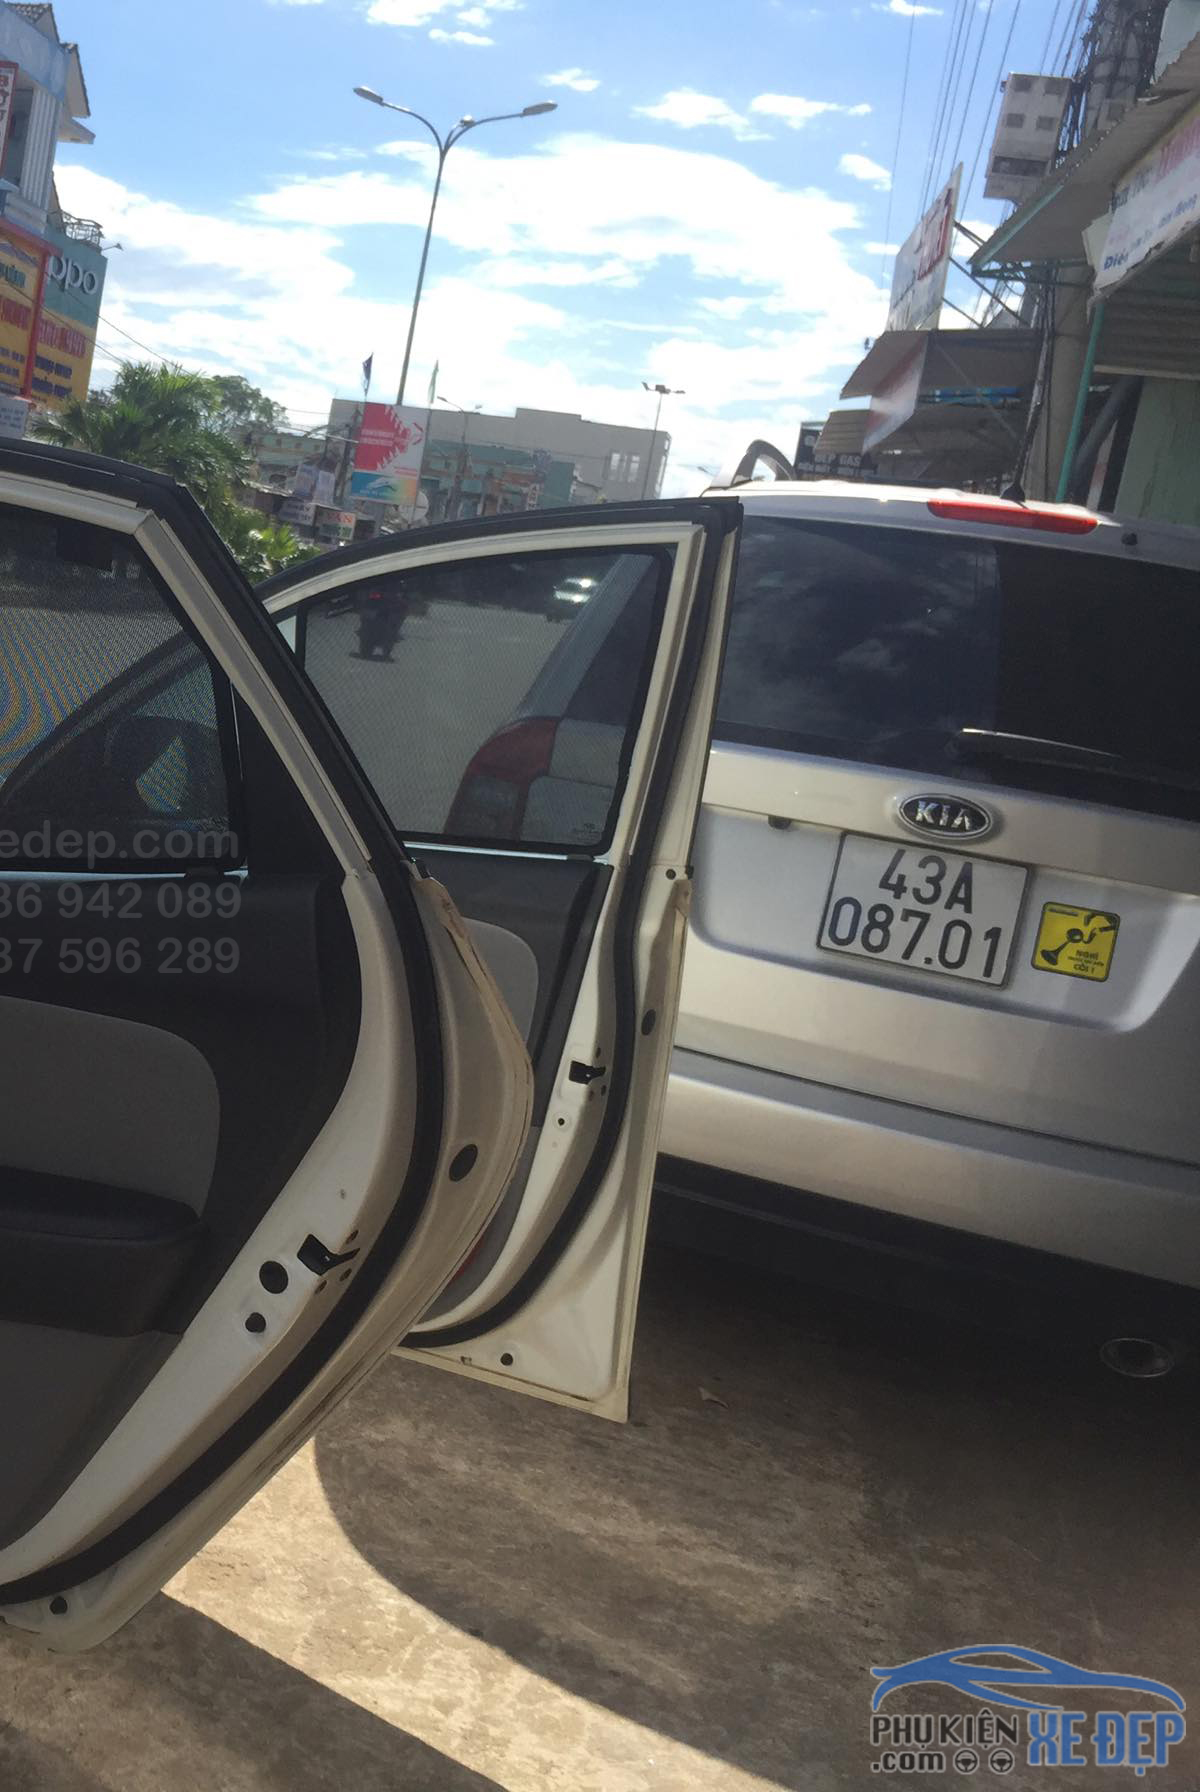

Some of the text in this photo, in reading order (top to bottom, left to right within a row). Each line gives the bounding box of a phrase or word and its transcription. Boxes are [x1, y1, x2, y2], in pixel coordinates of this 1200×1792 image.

[49, 254, 98, 295] ppo
[915, 800, 972, 831] KIA
[878, 849, 973, 914] 43A
[828, 896, 1002, 979] 087.01
